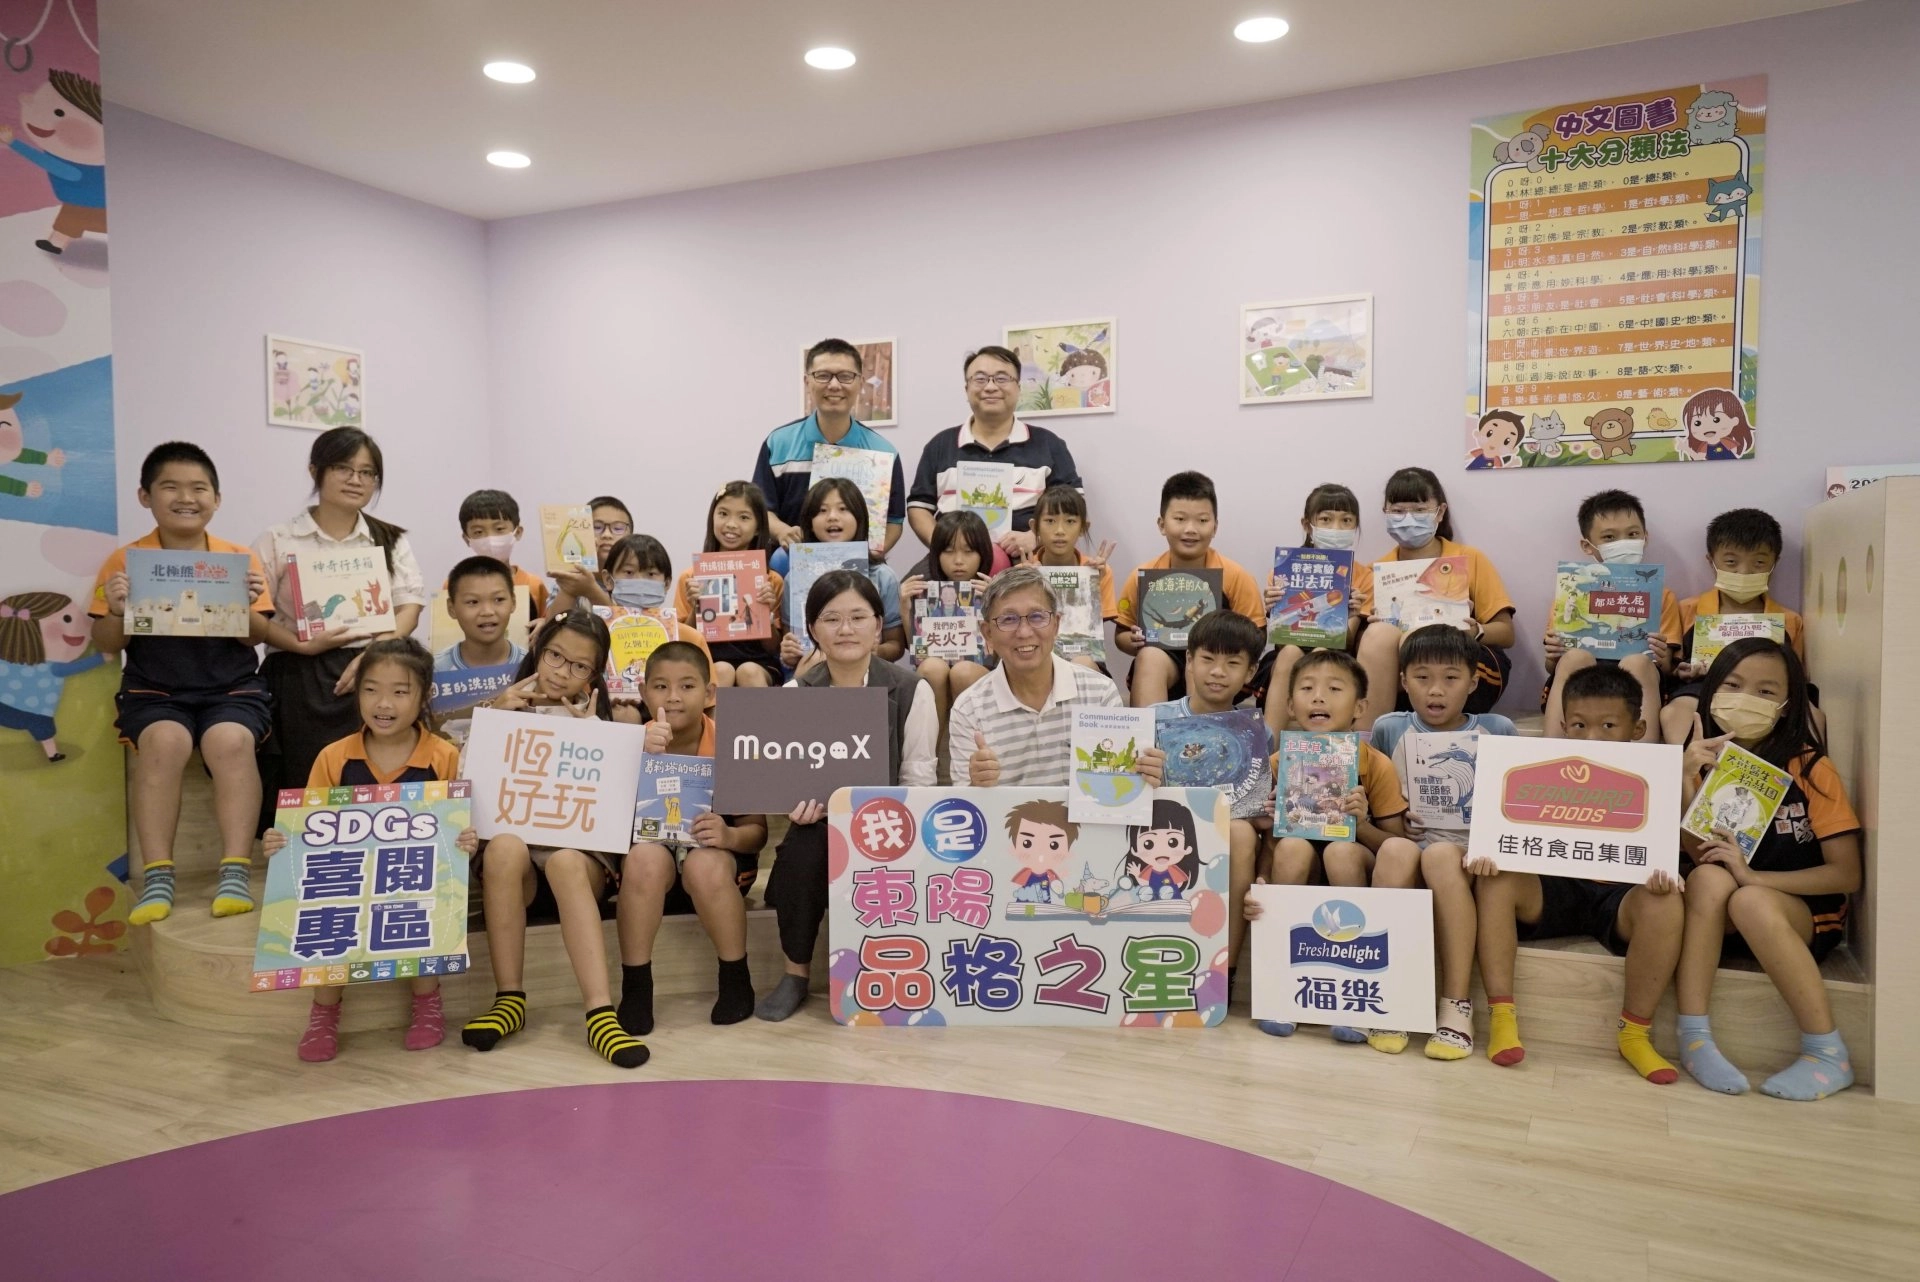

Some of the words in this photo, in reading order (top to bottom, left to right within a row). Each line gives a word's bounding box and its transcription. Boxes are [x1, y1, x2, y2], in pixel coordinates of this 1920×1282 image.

[1555, 97, 1679, 140] 中文圖書
[1539, 129, 1691, 172] 十大分類法
[1851, 479, 1879, 489] 20
[1290, 573, 1334, 590] 出去玩
[1595, 594, 1645, 607] 都是放屁
[927, 632, 971, 647] 失火了
[933, 620, 967, 630] 我們的家
[1079, 712, 1140, 722] Communication
[1079, 720, 1098, 728] Book
[559, 740, 605, 762] Hao
[557, 761, 601, 782] Fun
[494, 777, 598, 833] 好玩
[1516, 783, 1636, 813] STANDARD
[1538, 804, 1607, 823] FOODS
[302, 806, 438, 847] SDGs
[860, 808, 975, 853] 我是
[1497, 834, 1648, 866] 佳格食品集團
[301, 844, 437, 901] 喜閱
[852, 865, 993, 929] 東陽
[291, 900, 434, 961] 專區
[854, 931, 1201, 1015] 品格之星
[1294, 976, 1389, 1015] 福樂
